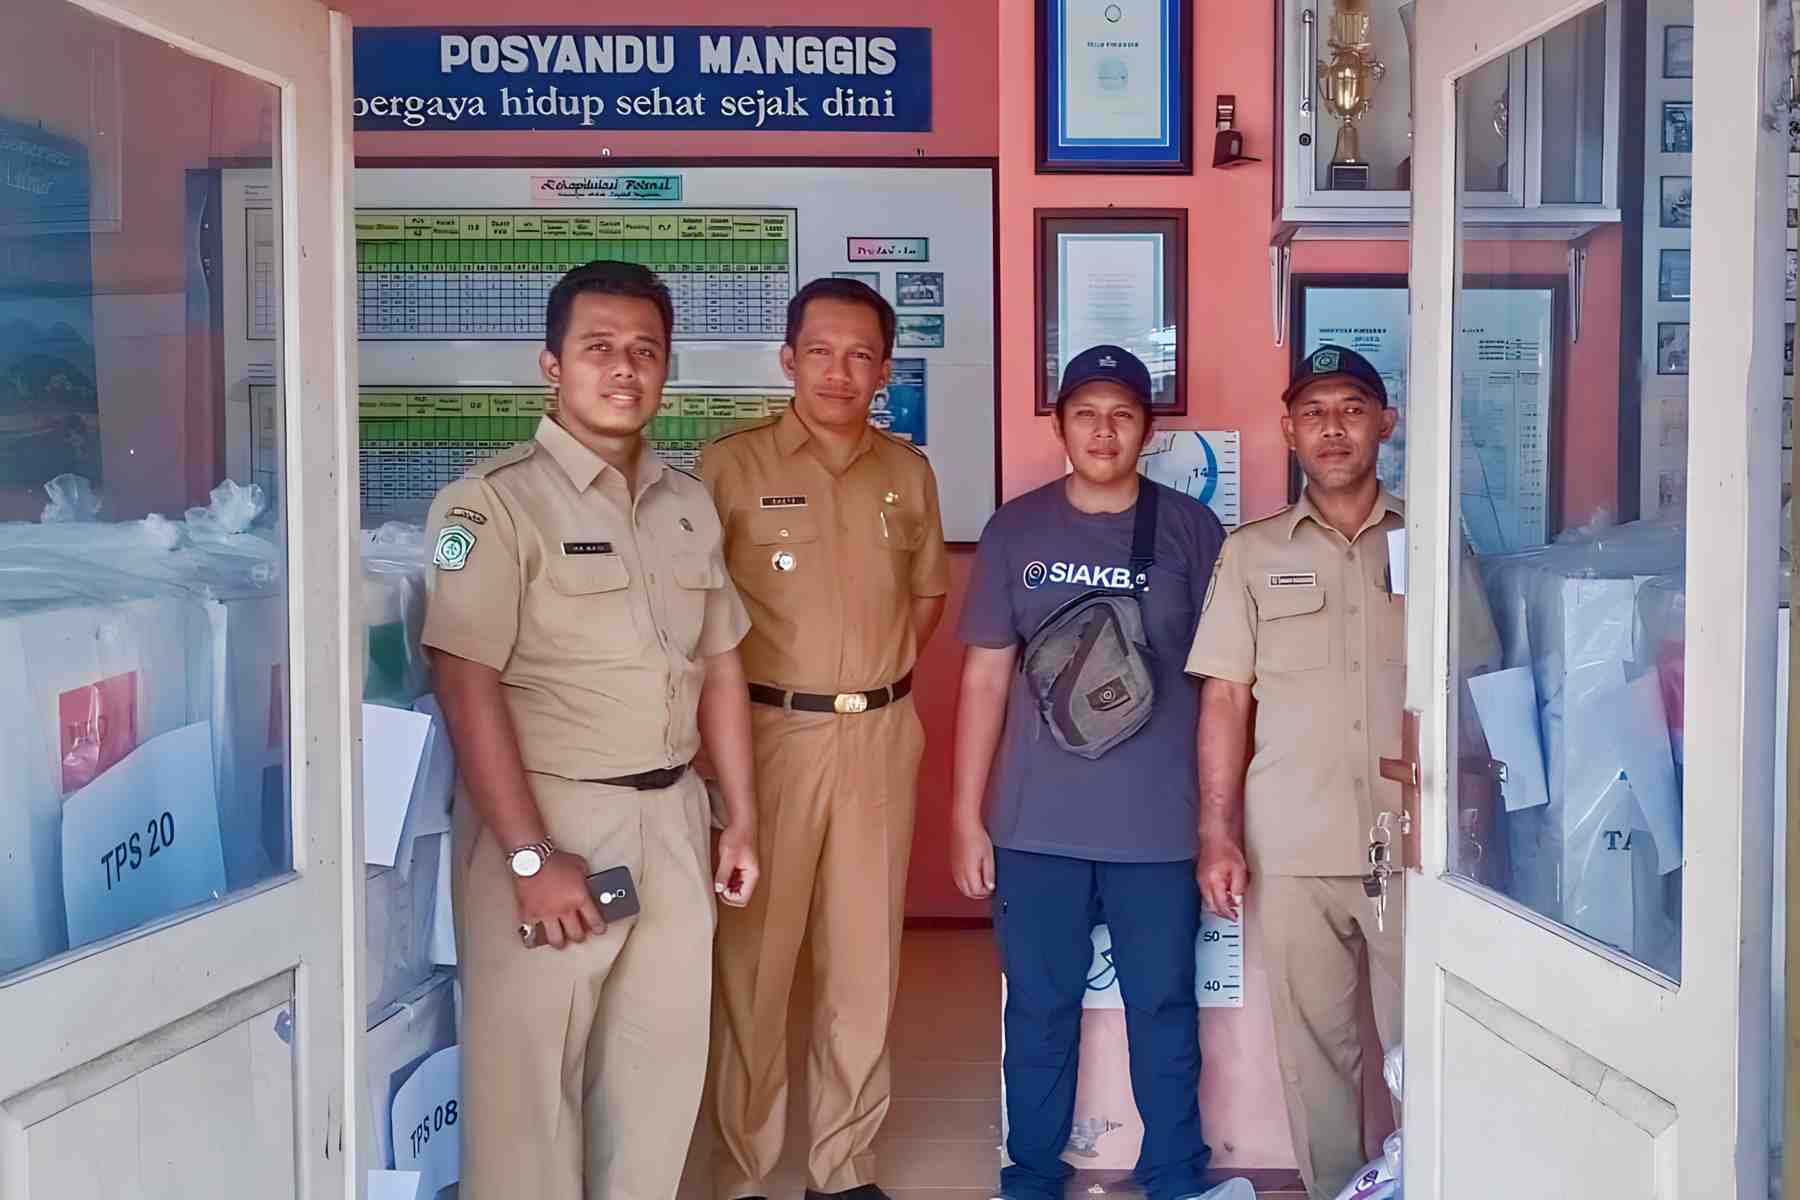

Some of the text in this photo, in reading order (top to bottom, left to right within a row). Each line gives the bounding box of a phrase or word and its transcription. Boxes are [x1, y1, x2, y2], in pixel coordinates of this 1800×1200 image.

[440, 35, 897, 76] POSYANDU MANGGIS
[501, 85, 604, 126] hidup
[616, 87, 706, 116] sehat
[720, 86, 809, 127] sejak
[822, 86, 896, 117] dini
[1050, 561, 1149, 591] SIAKB
[101, 811, 175, 890] TPS 20
[1203, 930, 1220, 942] 50
[1203, 980, 1221, 992] 40
[410, 1099, 458, 1160] TPS 08
